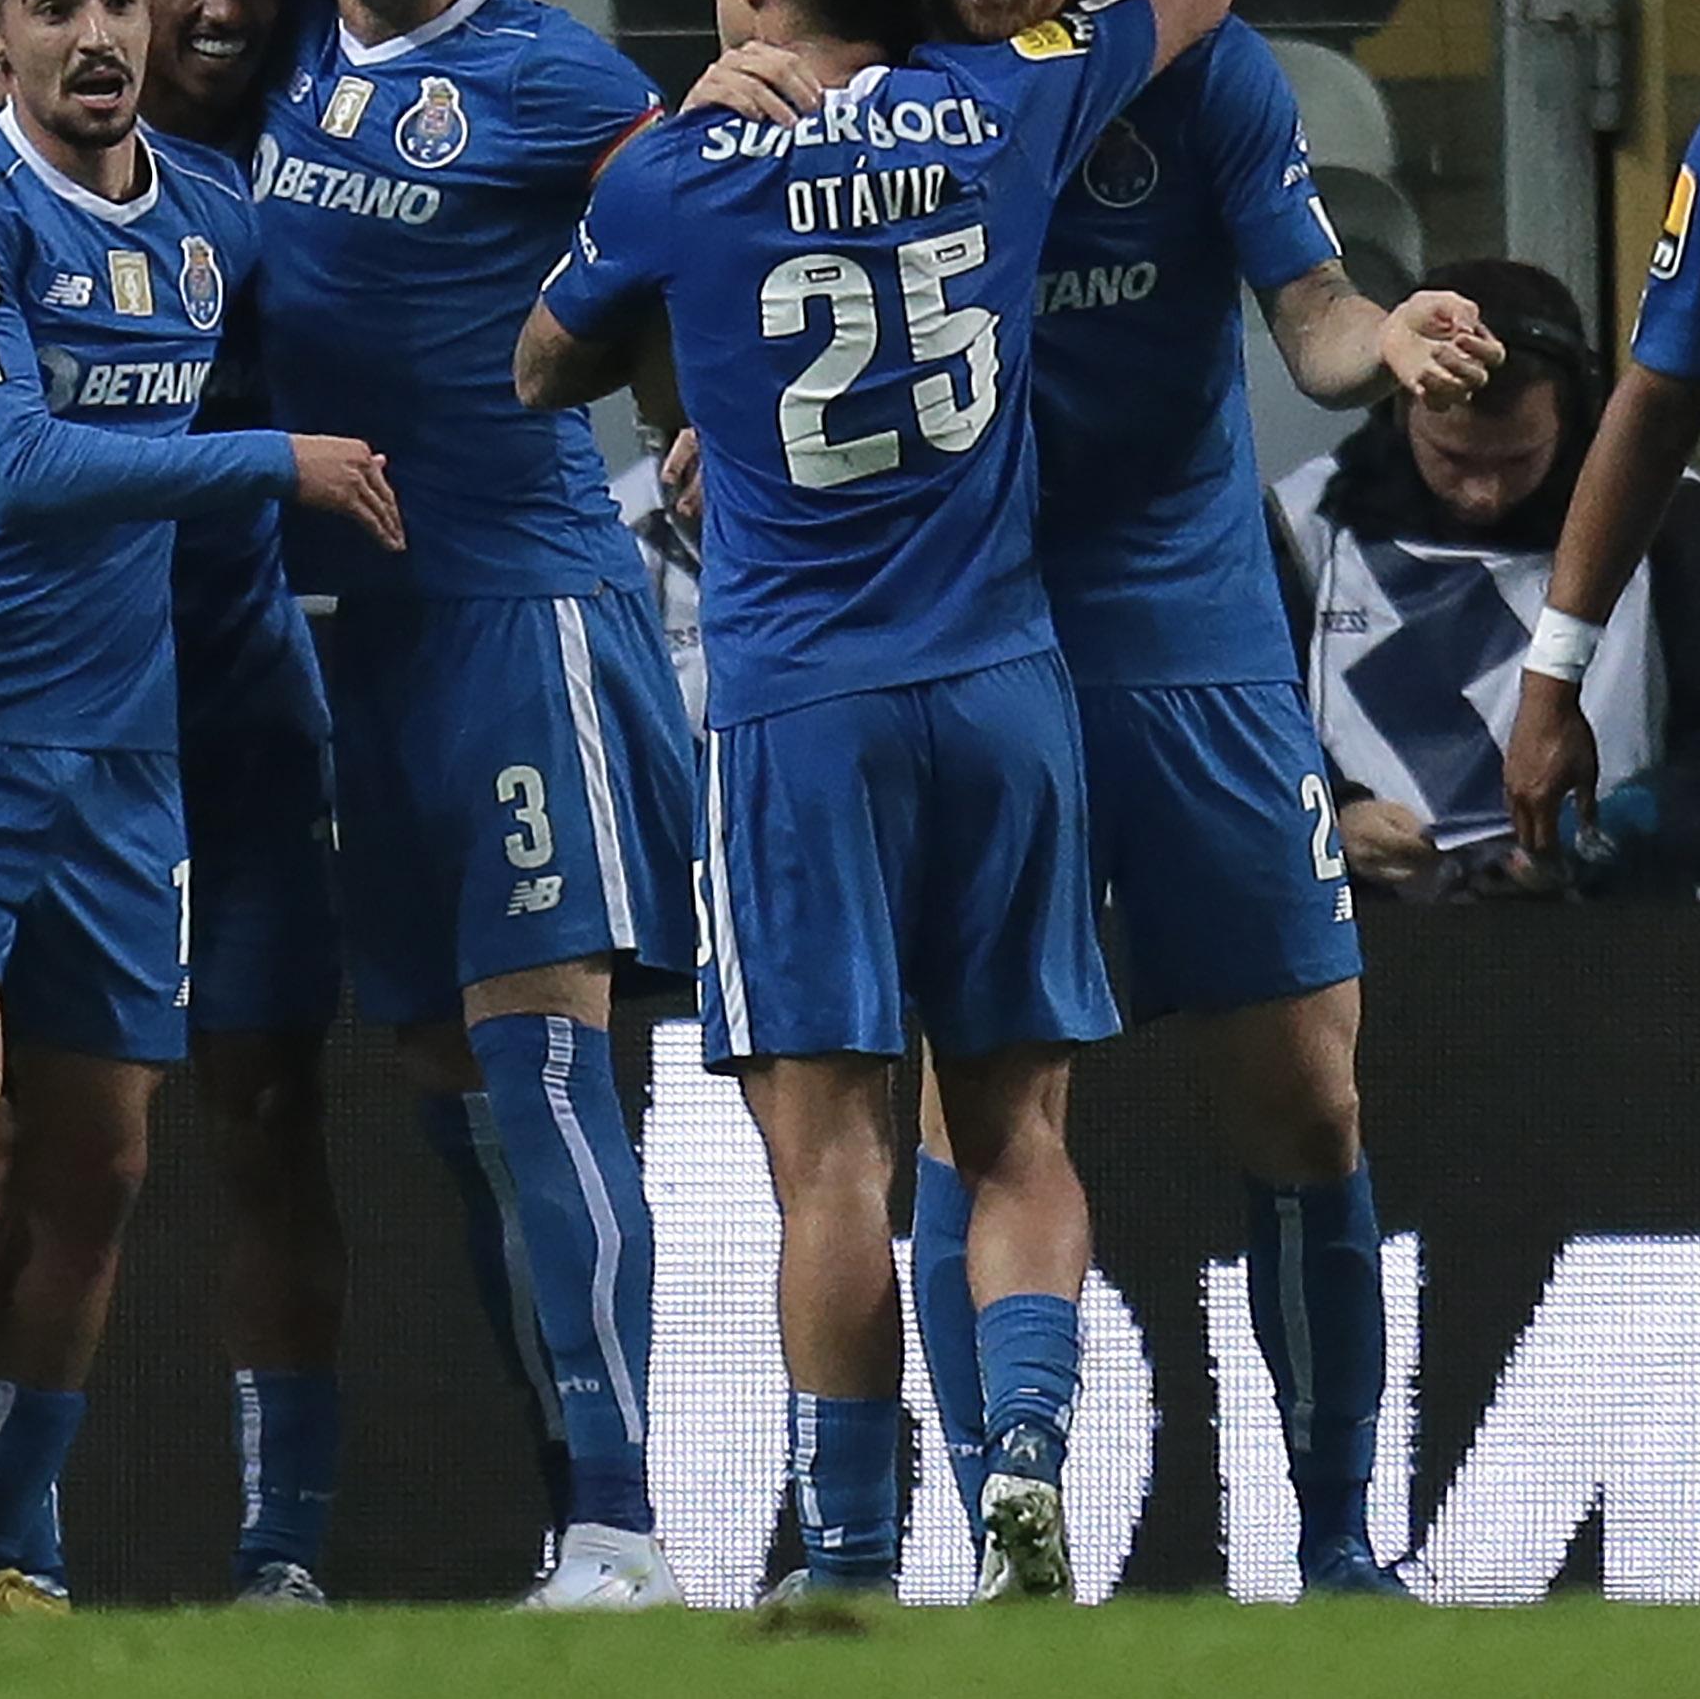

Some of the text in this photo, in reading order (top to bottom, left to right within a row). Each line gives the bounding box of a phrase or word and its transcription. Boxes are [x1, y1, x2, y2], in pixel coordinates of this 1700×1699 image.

[273, 157, 441, 225] BETANO
[787, 154, 946, 233] OTÁVIO
[760, 225, 999, 489] 25
[496, 764, 554, 870] 3
[1301, 773, 1347, 881] 2
